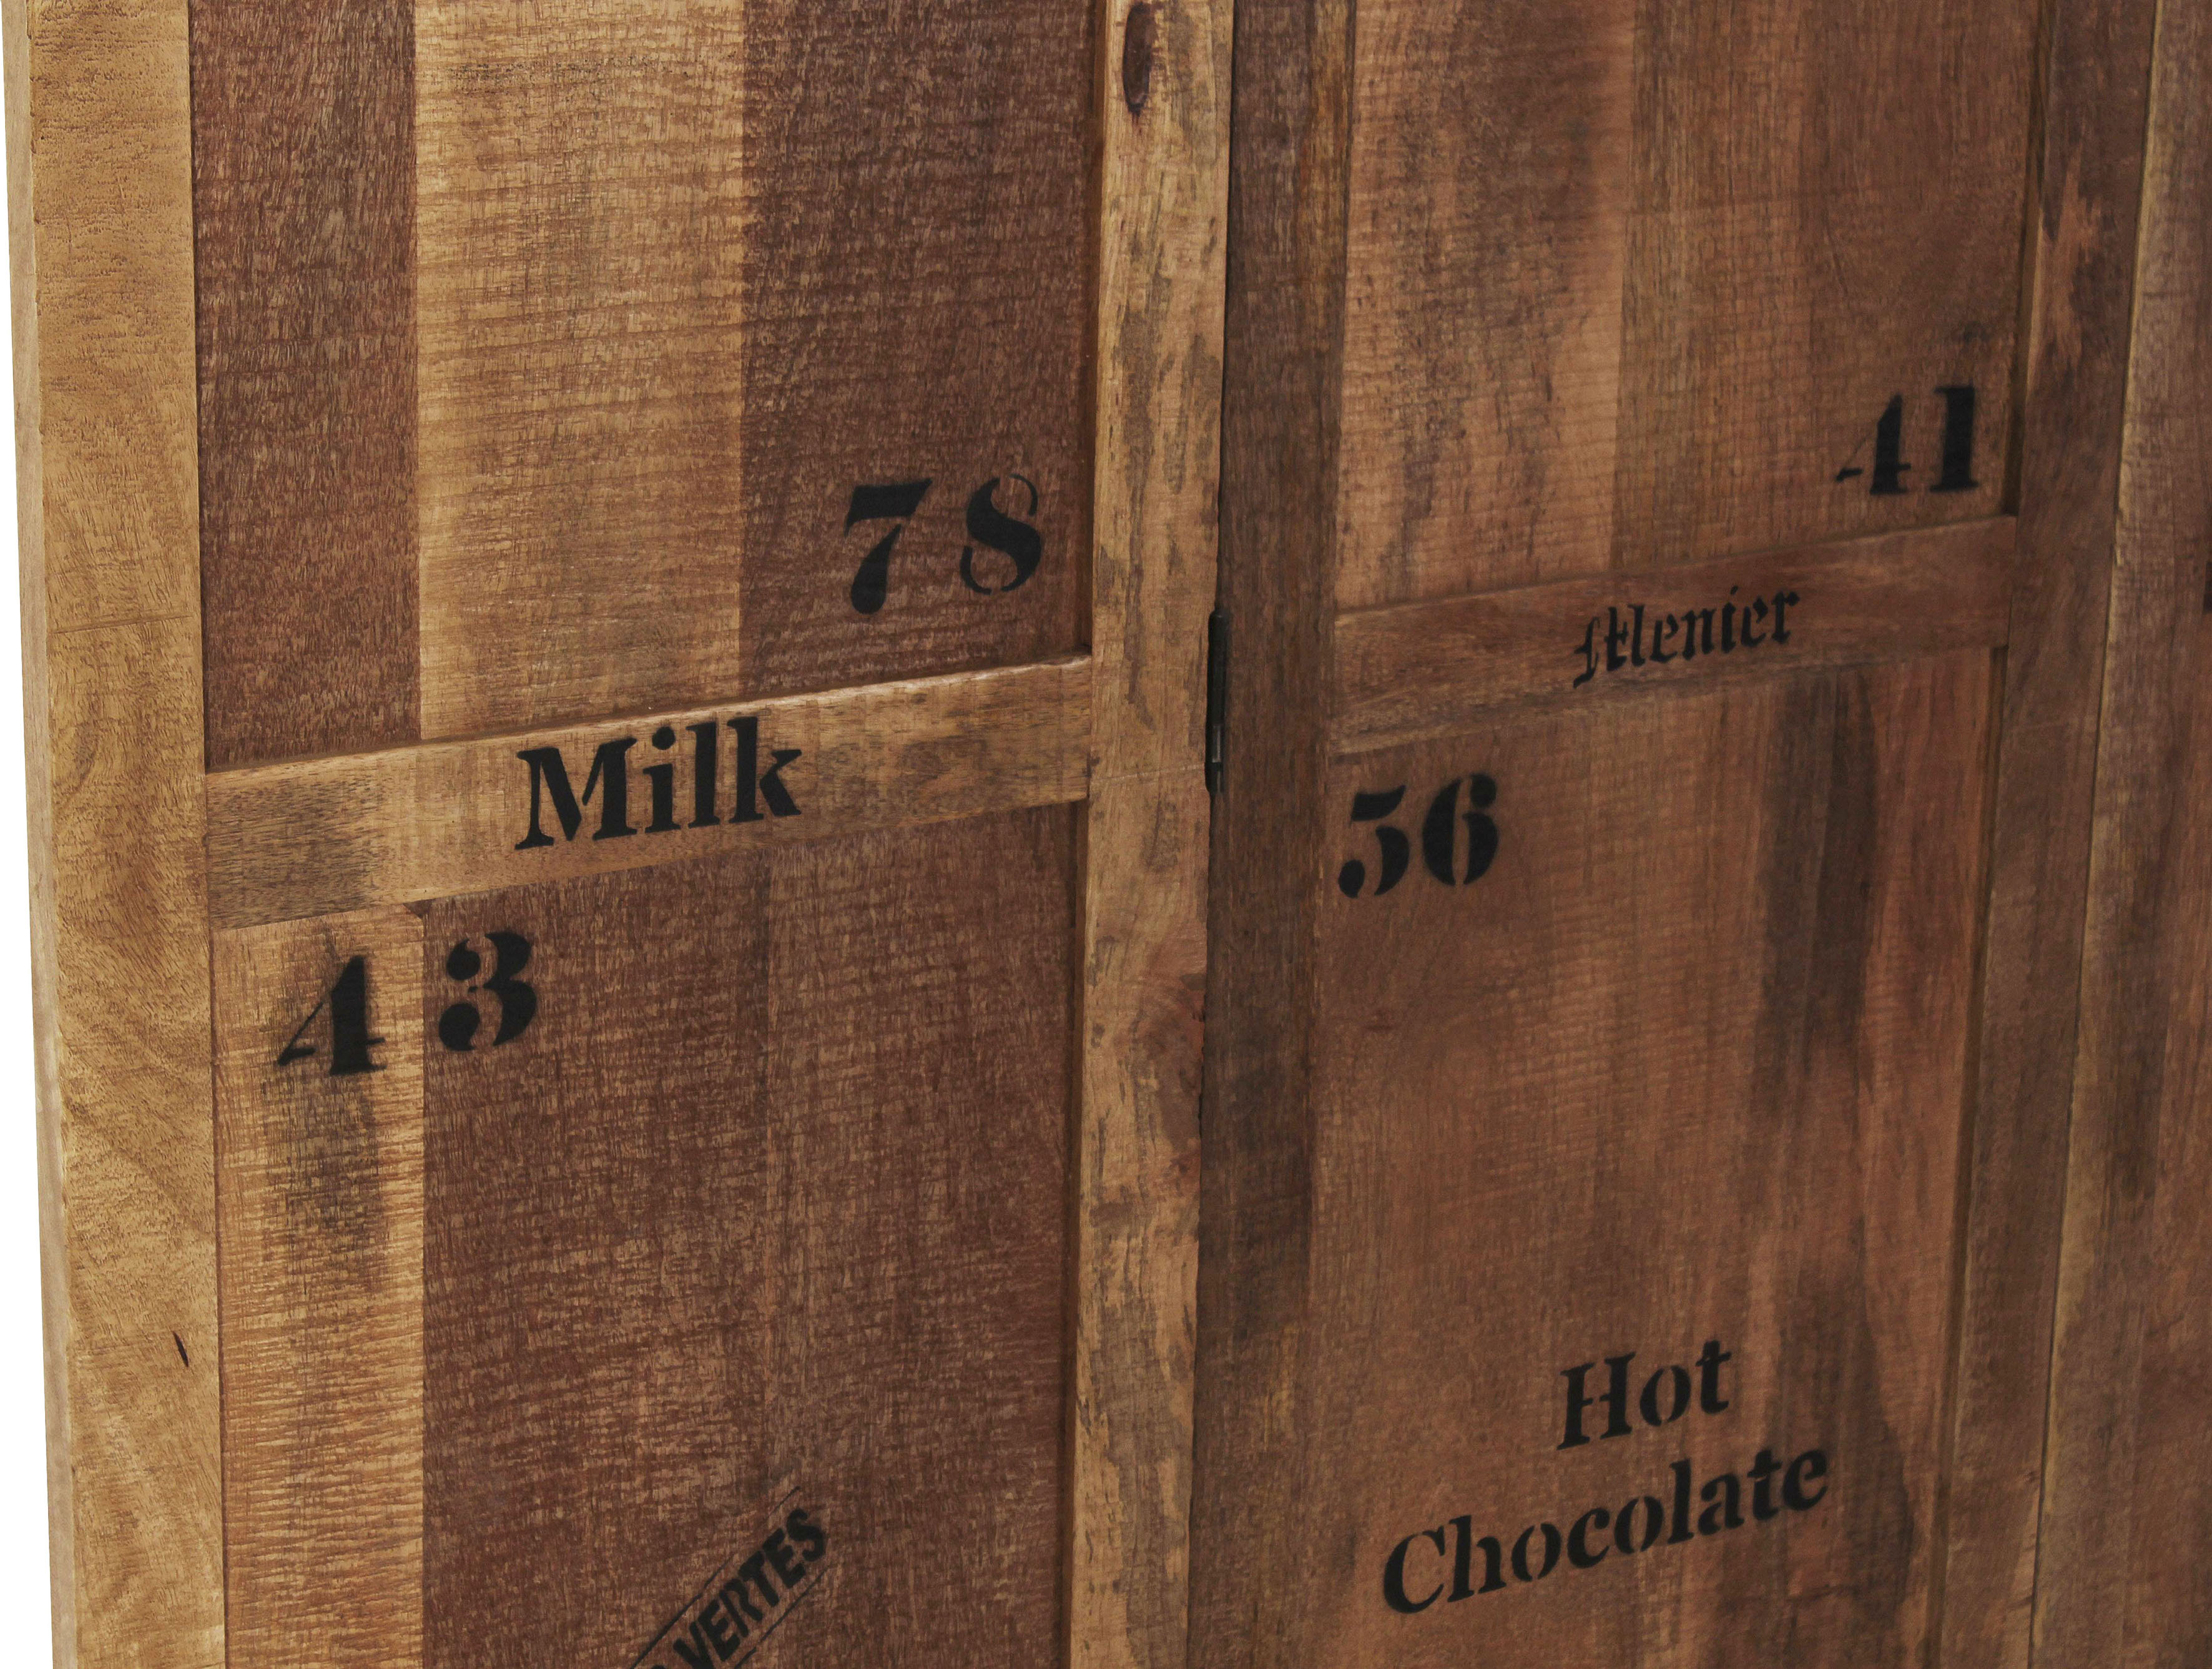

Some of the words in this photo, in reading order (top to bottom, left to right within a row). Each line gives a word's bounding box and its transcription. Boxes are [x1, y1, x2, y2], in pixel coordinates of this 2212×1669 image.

[1835, 383, 1979, 495] 41
[843, 473, 1042, 614] 78
[1573, 585, 1801, 689] Menier
[514, 716, 802, 850] Milk
[1337, 772, 1498, 899] 56
[277, 932, 538, 1076] 43
[1556, 1339, 1733, 1451] Hot
[672, 1508, 827, 1669] VERTES
[1382, 1449, 1828, 1615] Chocolate
